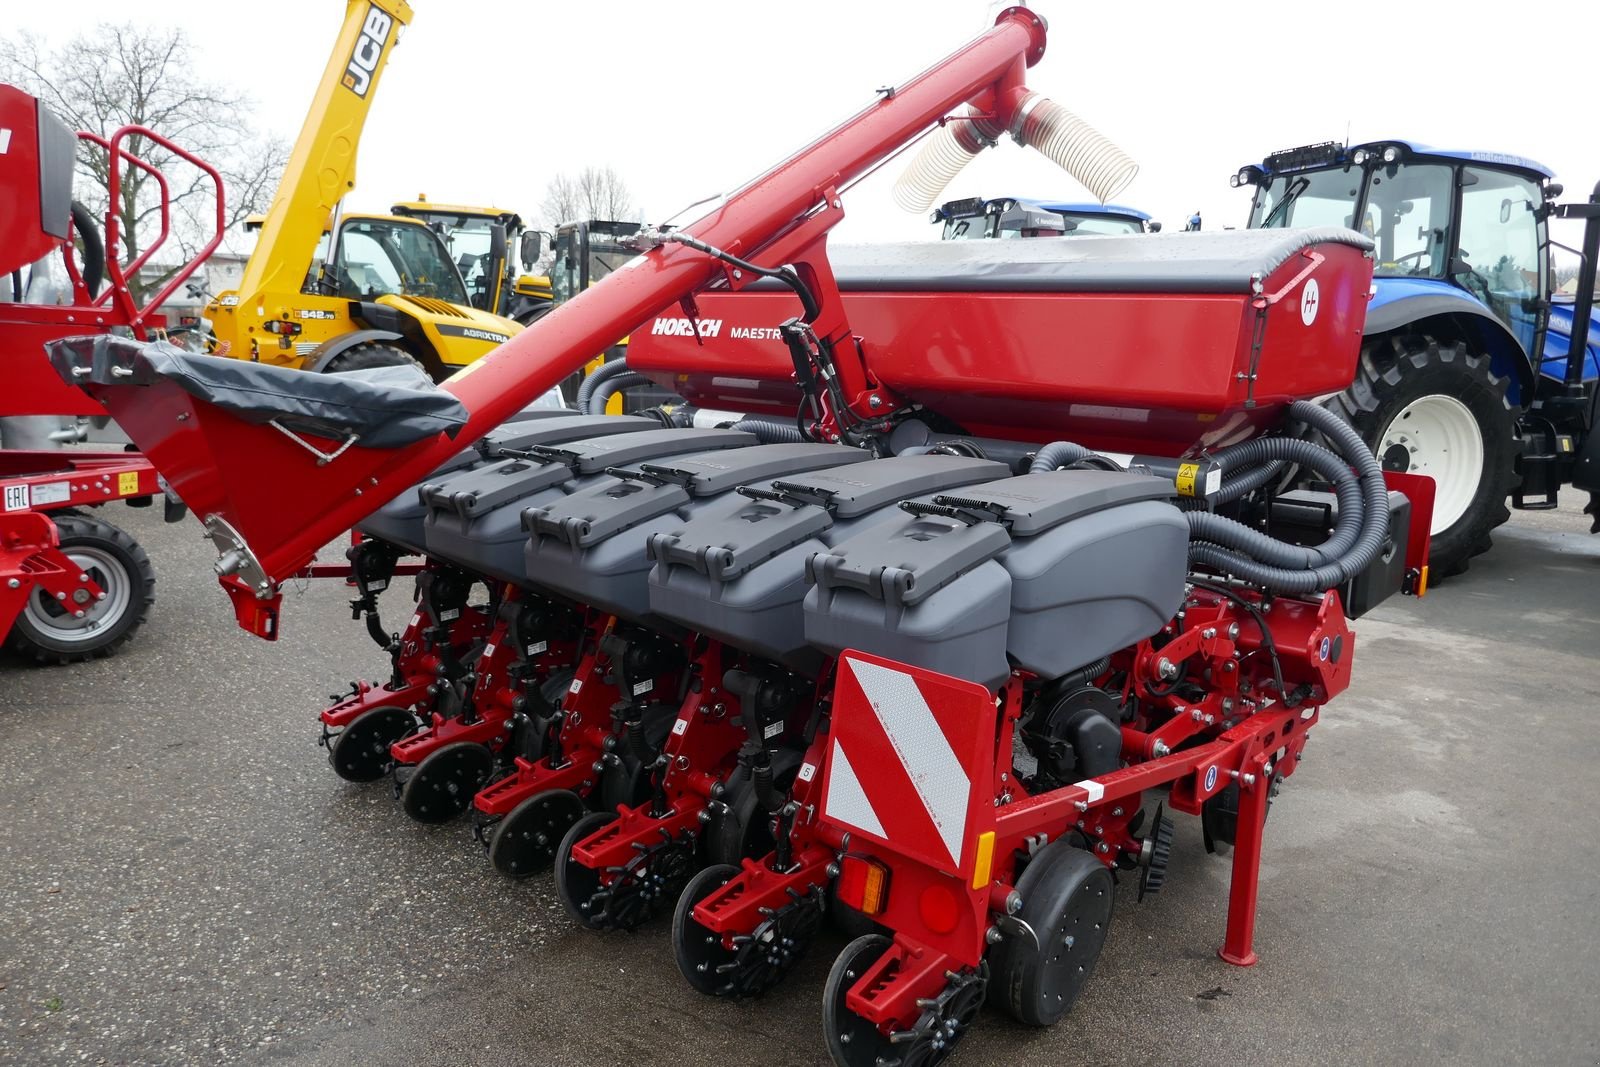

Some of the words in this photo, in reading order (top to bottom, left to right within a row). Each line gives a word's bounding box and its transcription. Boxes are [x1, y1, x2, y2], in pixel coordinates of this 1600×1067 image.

[348, 6, 392, 95] JCB
[651, 318, 722, 337] HORSCH
[730, 328, 783, 339] MAESTR
[7, 486, 27, 508] EAC
[803, 767, 811, 777] 5
